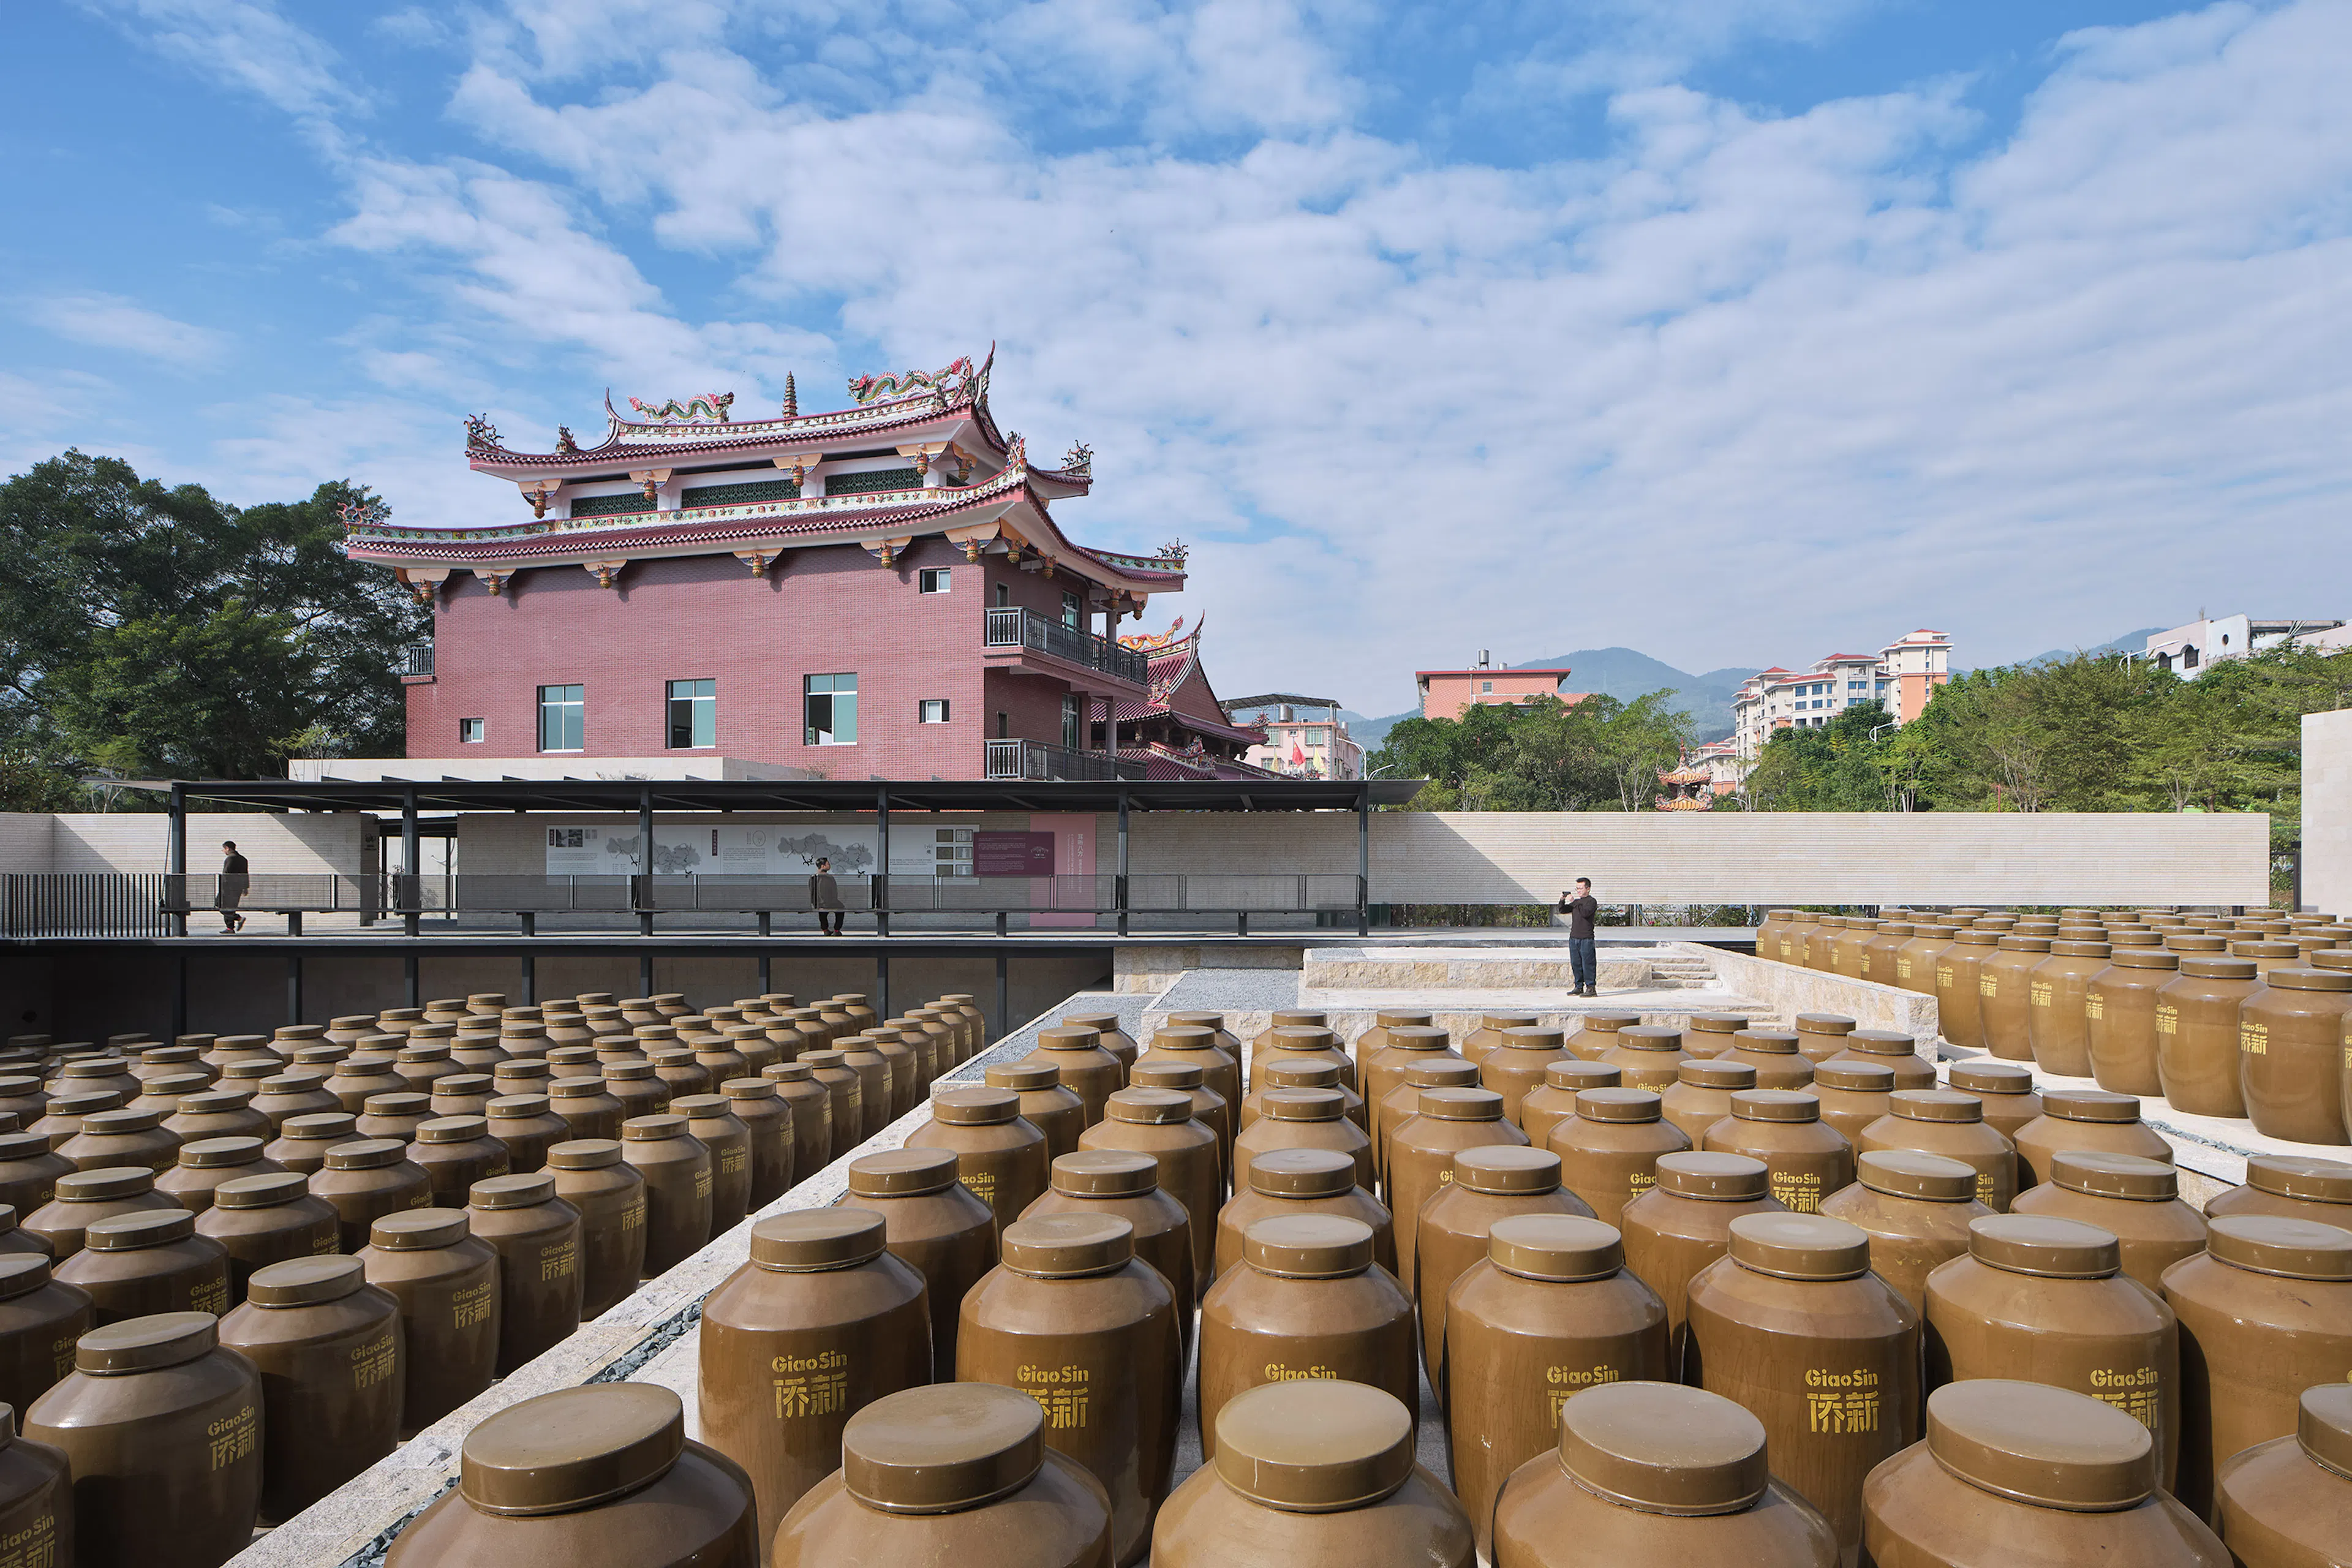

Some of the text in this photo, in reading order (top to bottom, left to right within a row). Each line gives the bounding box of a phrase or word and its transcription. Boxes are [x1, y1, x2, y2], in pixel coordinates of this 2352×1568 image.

[2241, 1021, 2267, 1034] GiaoSin
[2241, 1032, 2267, 1055] 侨新
[1637, 1083, 1667, 1092] GiaoSi
[655, 1099, 670, 1109] GiaoS
[959, 1172, 995, 1185] iaoSin
[1630, 1172, 1656, 1185] Giao
[1773, 1171, 1820, 1185] GiaoSin
[540, 1240, 575, 1257] GiaoSin
[540, 1251, 575, 1281] 侨新
[190, 1276, 227, 1297] GiaoSin
[453, 1282, 491, 1303] GiaoSin
[453, 1294, 491, 1330] 侨新
[350, 1334, 394, 1362] GiaoSin
[352, 1348, 396, 1391] 侨新
[772, 1350, 848, 1373] GiaoSin
[1265, 1363, 1337, 1381] GiaoSin
[1017, 1365, 1089, 1382] GiaoSin
[1547, 1365, 1619, 1384] GiaoSin
[1805, 1369, 1879, 1387] GiaoSin
[2089, 1367, 2158, 1387] GiaoSin
[772, 1371, 848, 1419] 侨新
[207, 1405, 255, 1437] GiaoSin
[1806, 1390, 1879, 1433] 侨新
[209, 1420, 256, 1471] 侨新
[0, 1514, 55, 1555] iaoSin
